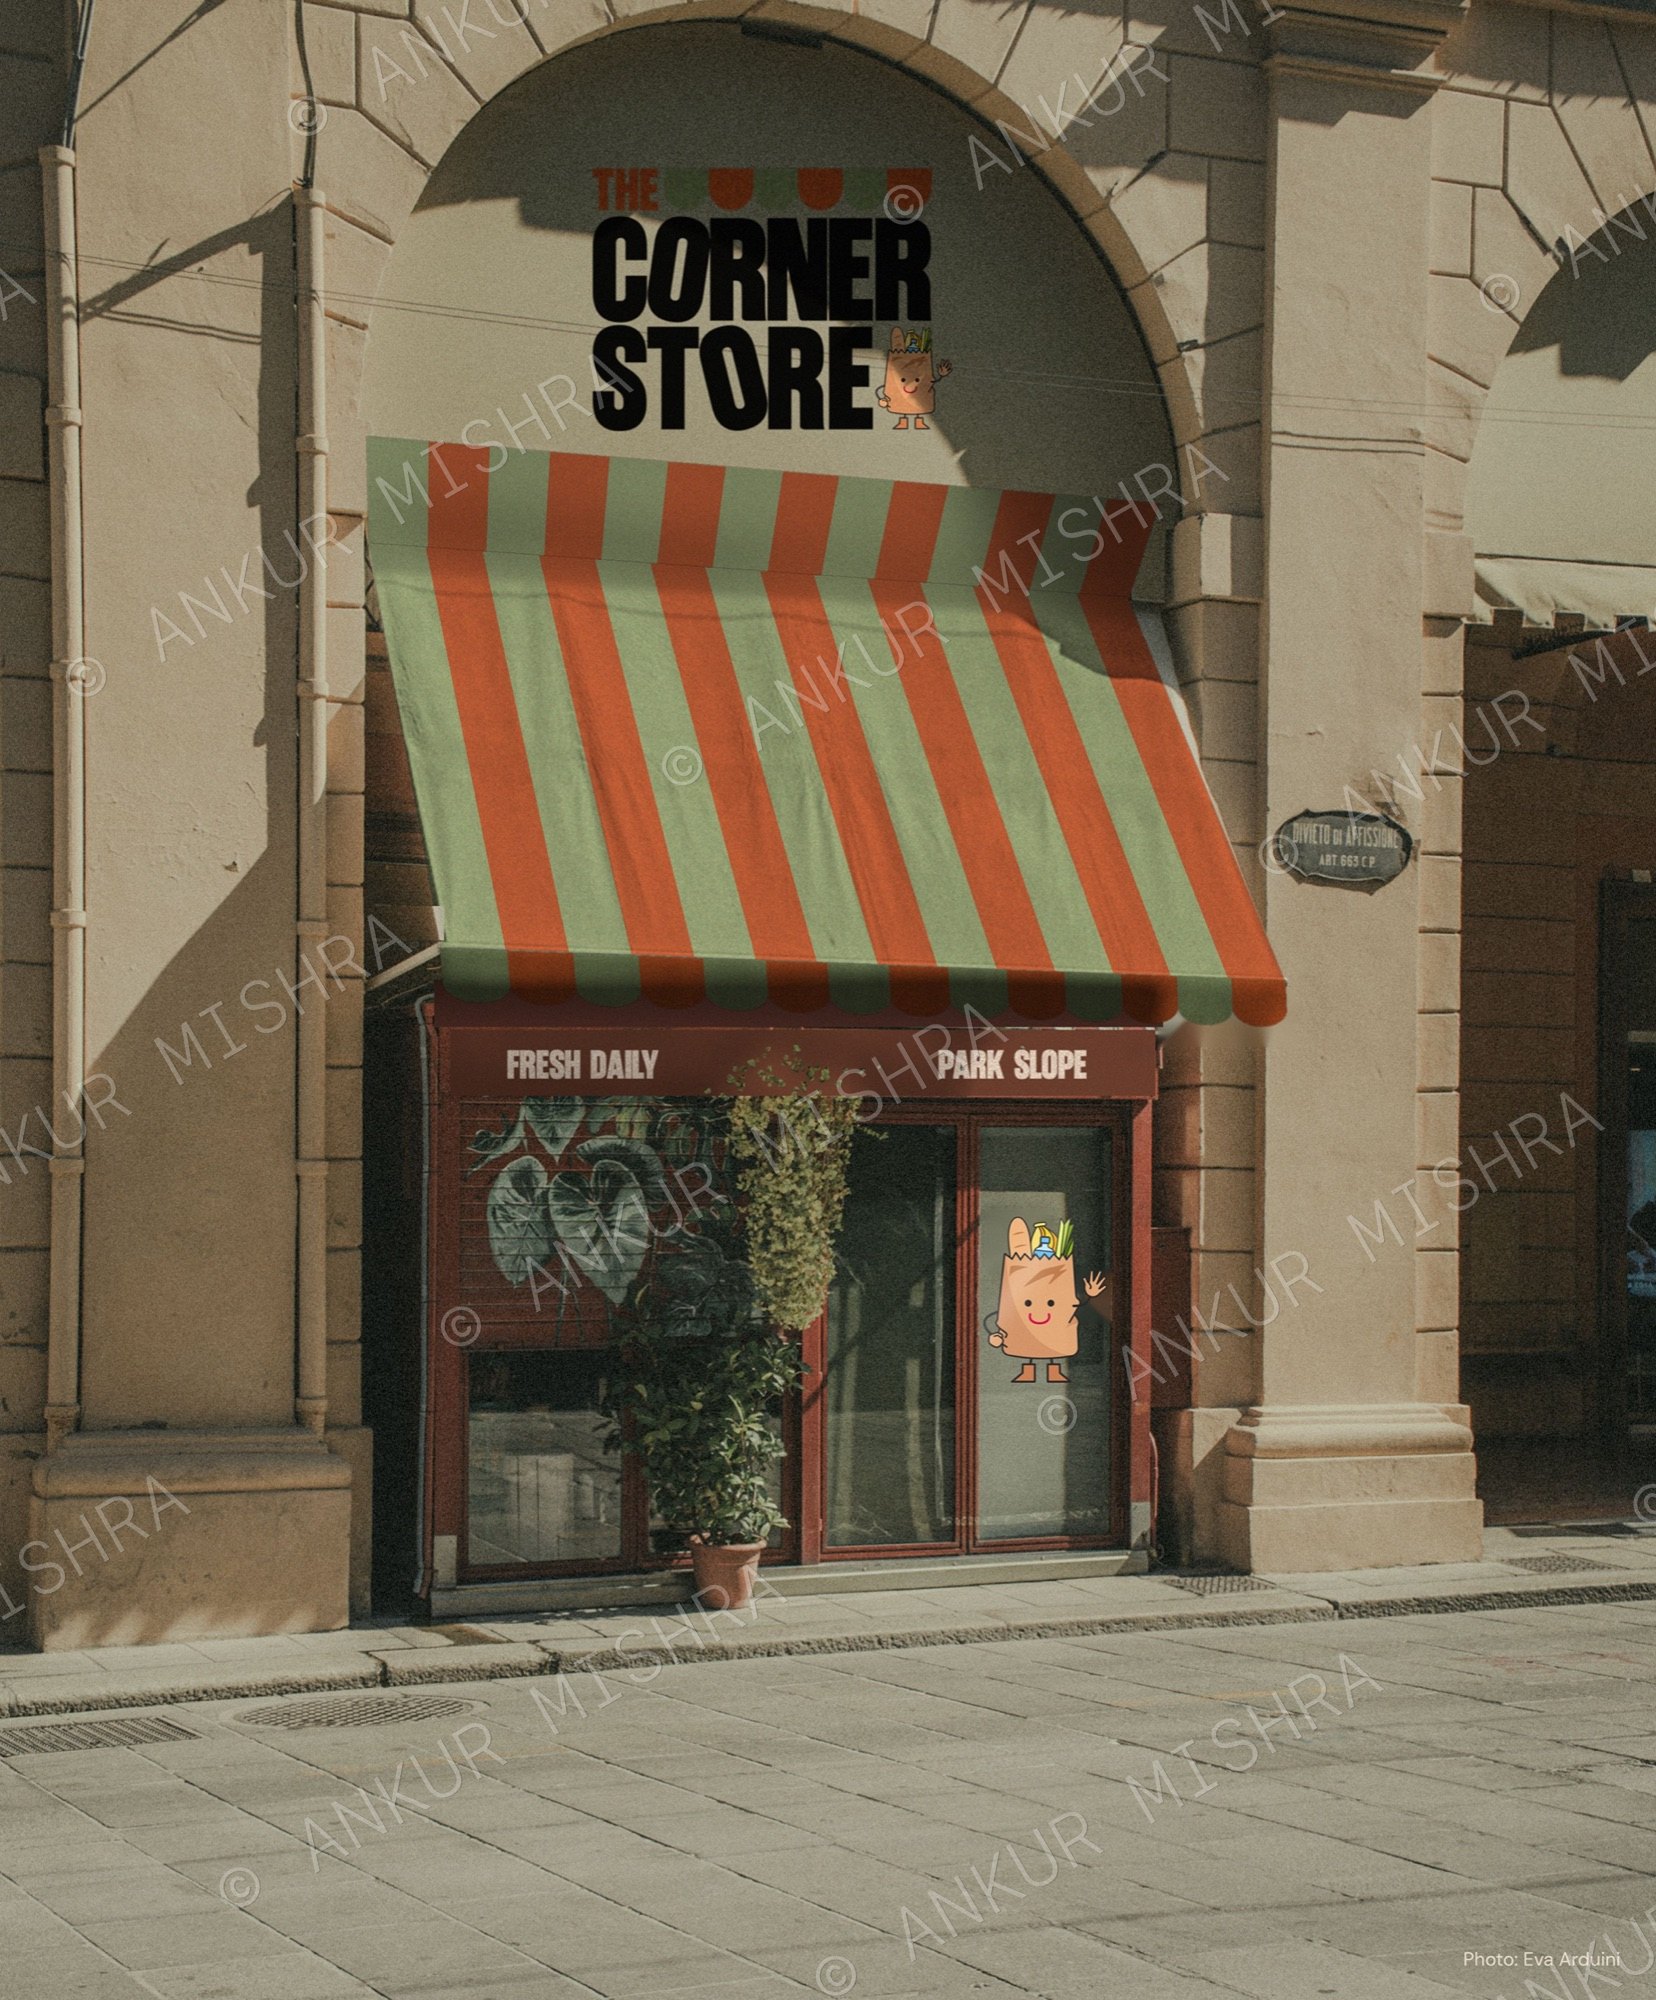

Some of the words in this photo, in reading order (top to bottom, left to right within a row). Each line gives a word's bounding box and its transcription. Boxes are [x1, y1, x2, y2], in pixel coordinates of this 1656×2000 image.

[592, 168, 659, 211] THE
[592, 216, 932, 322] CORNER
[592, 325, 873, 431] STORE
[1292, 822, 1331, 845] DIVIETO
[1345, 825, 1399, 848] AFFISSIONE
[1340, 854, 1359, 868] 663
[507, 1049, 581, 1080] FRESH
[590, 1050, 659, 1080] DAILY
[938, 1050, 1005, 1080] PARK
[1014, 1049, 1087, 1080] SLOPE
